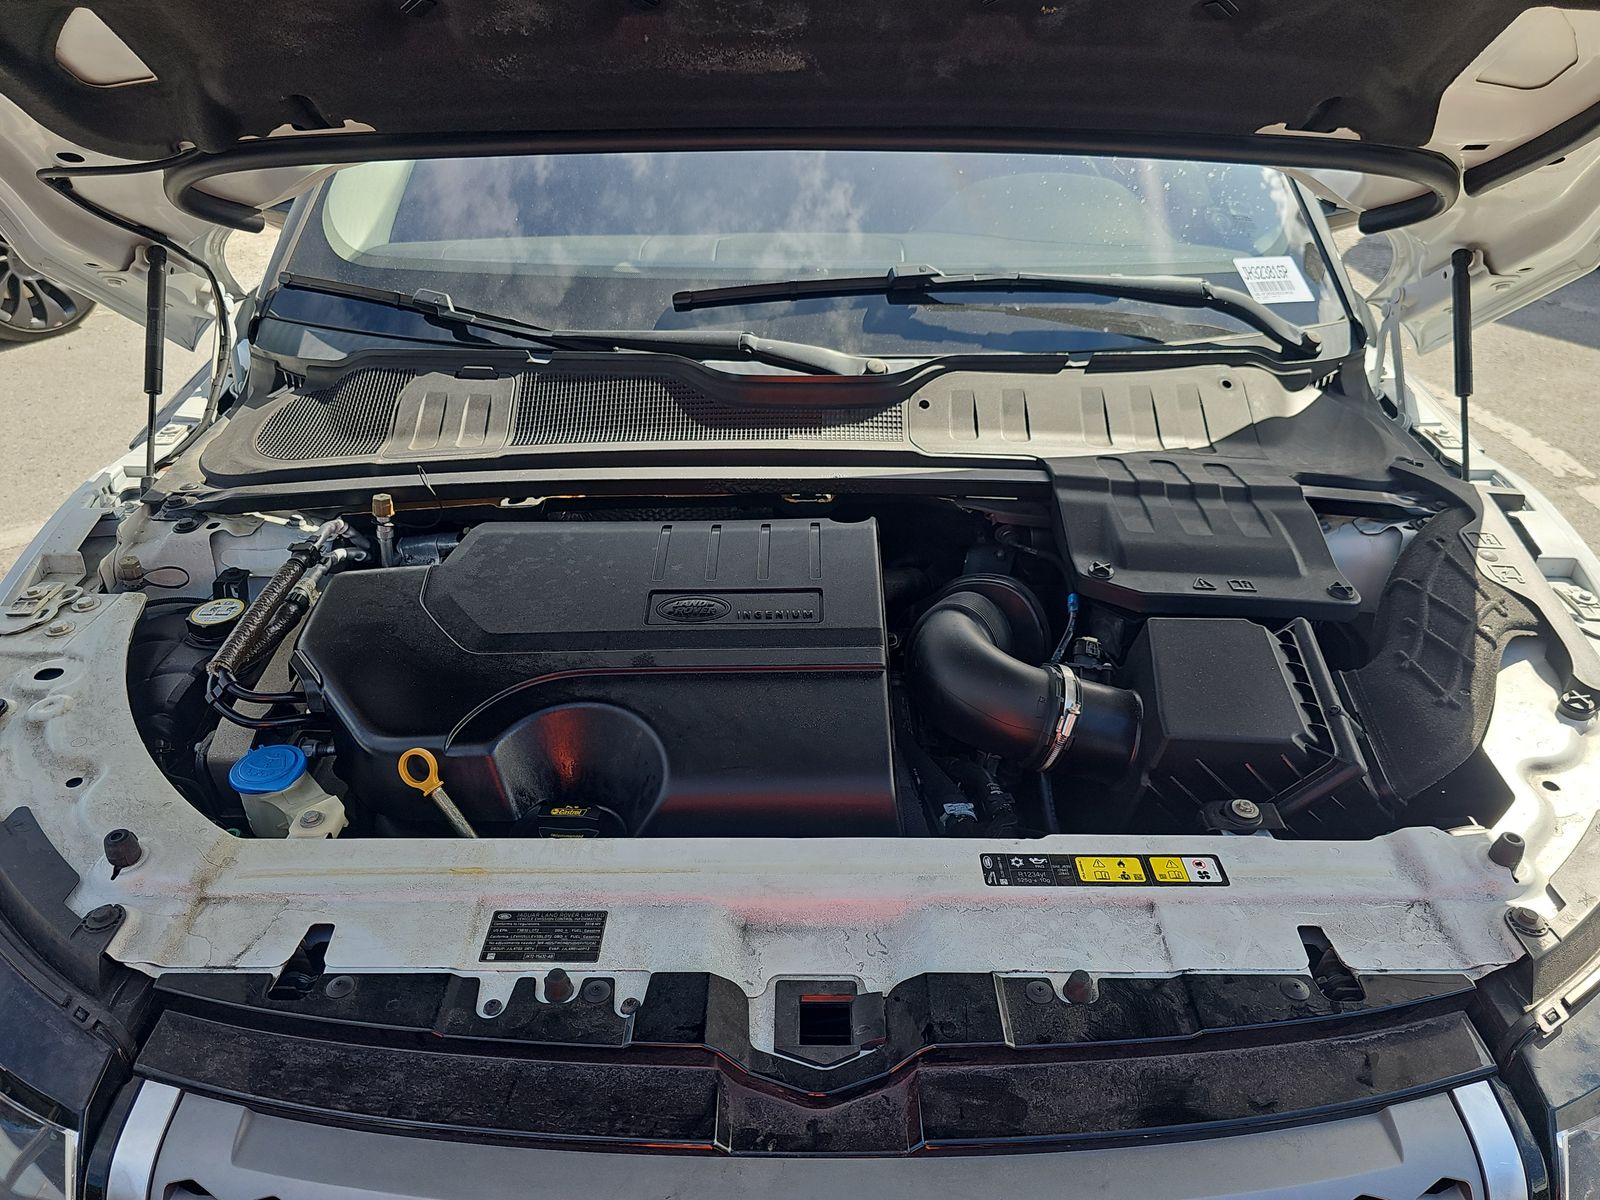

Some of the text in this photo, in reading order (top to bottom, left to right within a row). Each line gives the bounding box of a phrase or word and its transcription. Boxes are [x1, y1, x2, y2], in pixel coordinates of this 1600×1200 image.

[672, 600, 715, 608] LAND
[670, 606, 718, 616] ROVER
[736, 609, 814, 620] INGENIUM
